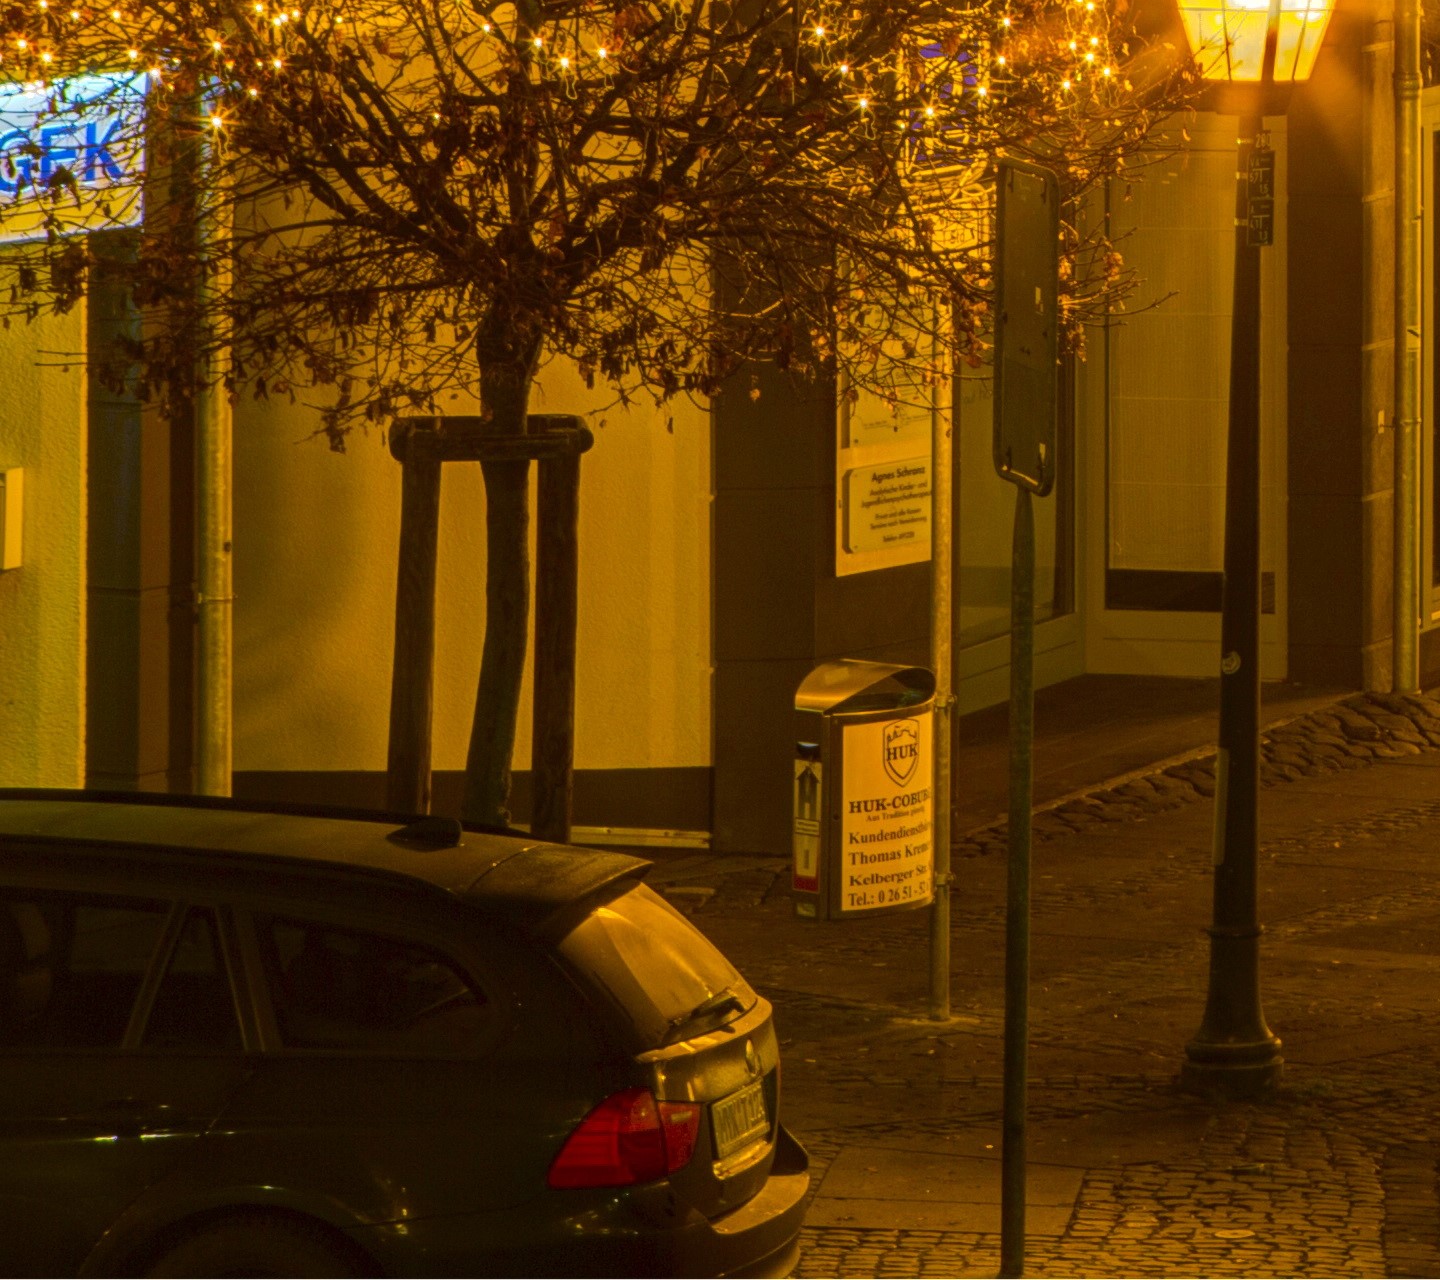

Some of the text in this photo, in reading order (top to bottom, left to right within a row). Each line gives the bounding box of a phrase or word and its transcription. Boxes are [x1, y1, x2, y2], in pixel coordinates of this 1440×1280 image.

[886, 743, 919, 762] HUK
[848, 849, 902, 866] Thomas
[849, 869, 914, 887] Kelberger
[848, 892, 875, 907] Tel.:
